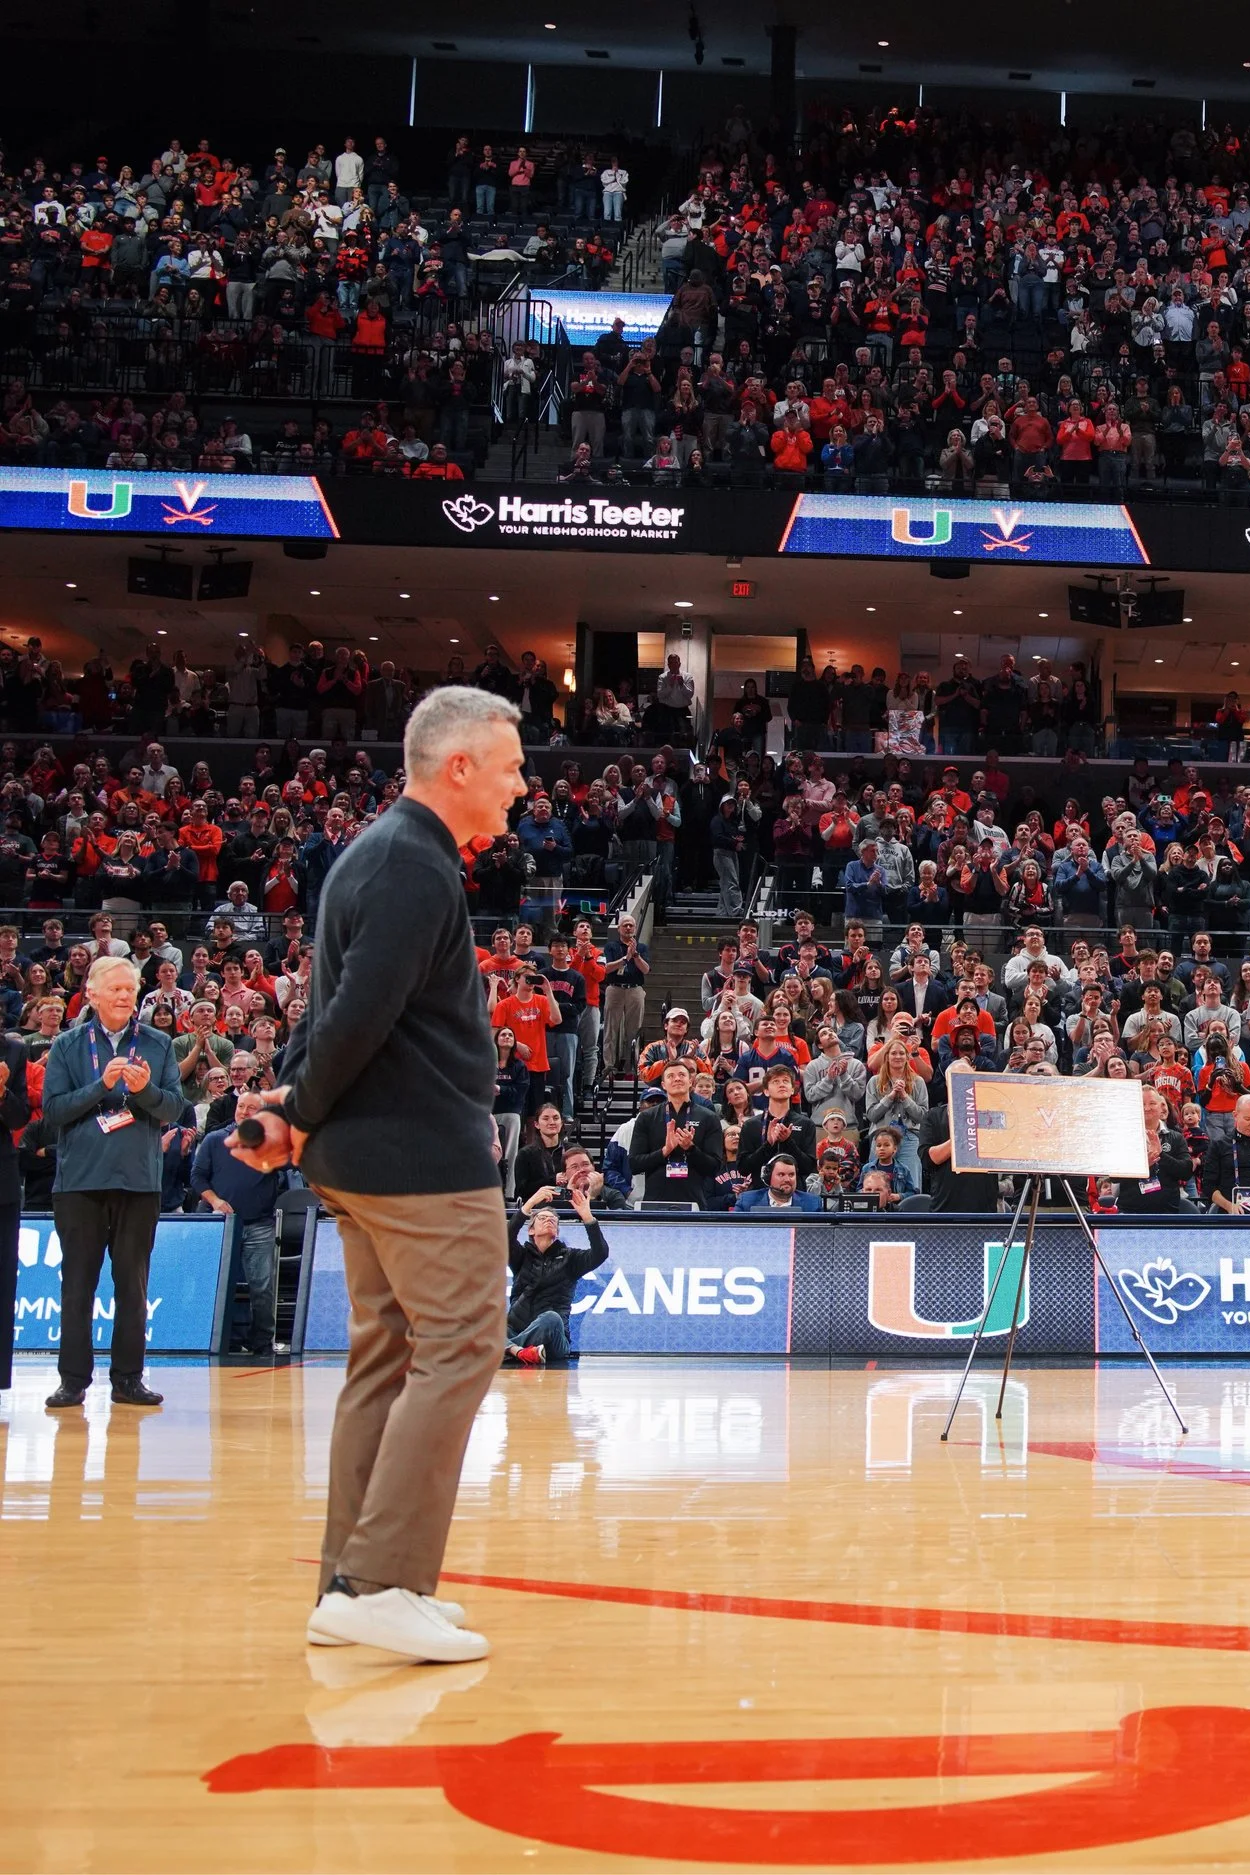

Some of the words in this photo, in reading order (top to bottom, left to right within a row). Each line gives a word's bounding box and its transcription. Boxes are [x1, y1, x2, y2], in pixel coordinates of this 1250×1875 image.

[68, 480, 132, 519] U
[498, 496, 588, 524] Harris
[499, 525, 528, 535] YOUR
[533, 526, 627, 538] NEIGHBORHOOD
[631, 529, 678, 539] MARKET
[892, 508, 952, 546] U
[733, 583, 750, 596] EXIT
[857, 995, 880, 1004] CAVALIE
[966, 1087, 977, 1151] VIRGINIA
[869, 1241, 1029, 1339] U
